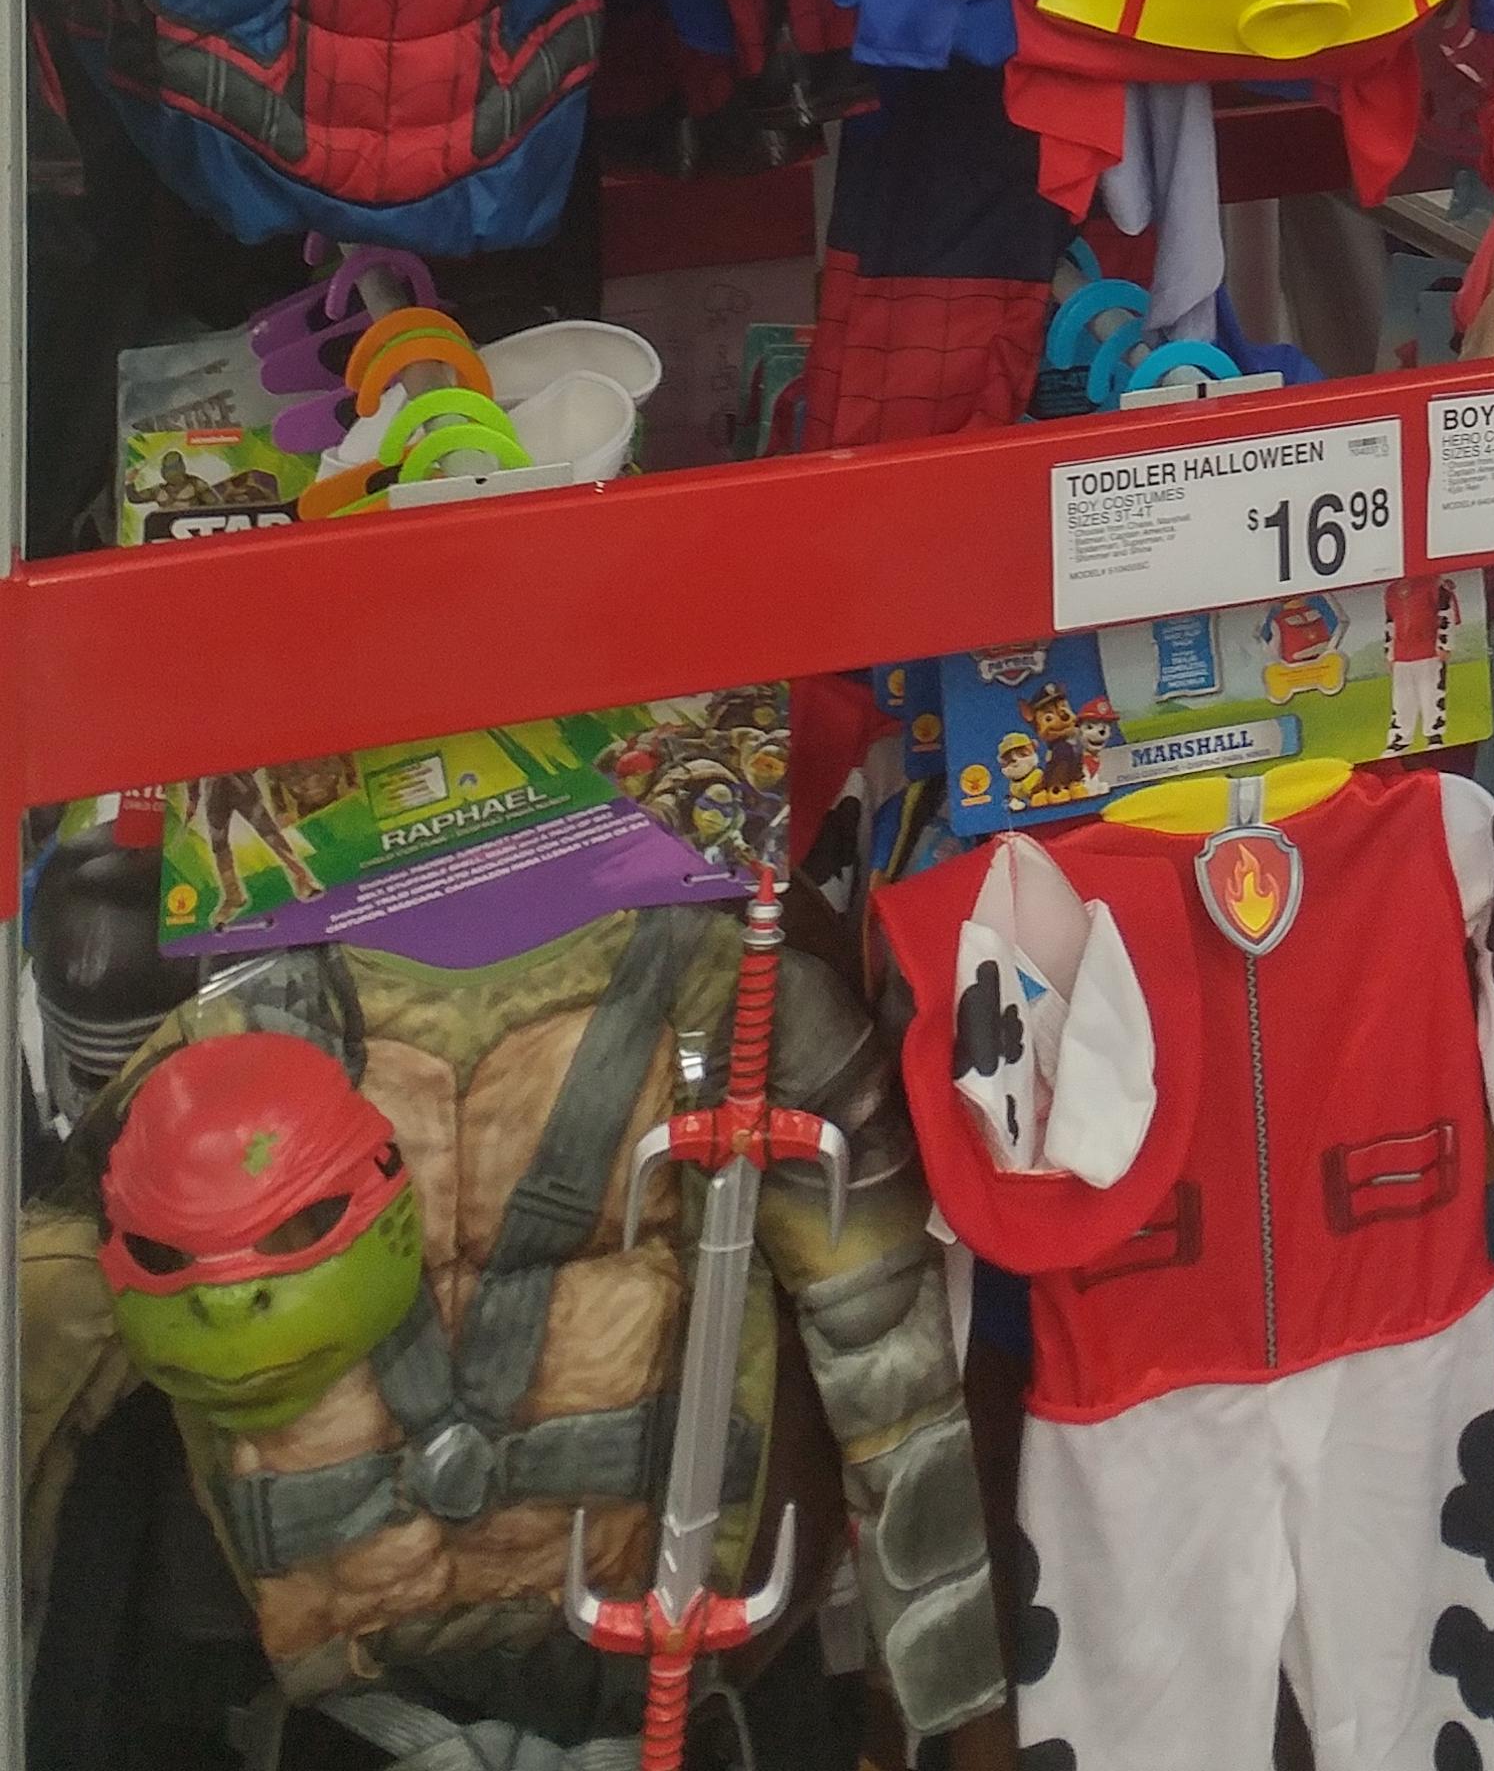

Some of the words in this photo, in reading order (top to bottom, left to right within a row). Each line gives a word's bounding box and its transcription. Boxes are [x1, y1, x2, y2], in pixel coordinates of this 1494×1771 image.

[1442, 432, 1480, 446] HERO
[1442, 445, 1480, 460] SIZES
[1067, 462, 1177, 498] TODDLER
[1184, 440, 1325, 482] HALLOWEEN
[1068, 500, 1097, 515] BOY
[1103, 487, 1185, 510] COSTUMES
[1068, 511, 1110, 529] SIZES
[1131, 730, 1254, 768] MARSHALL
[381, 786, 547, 850] RAPHAEL
